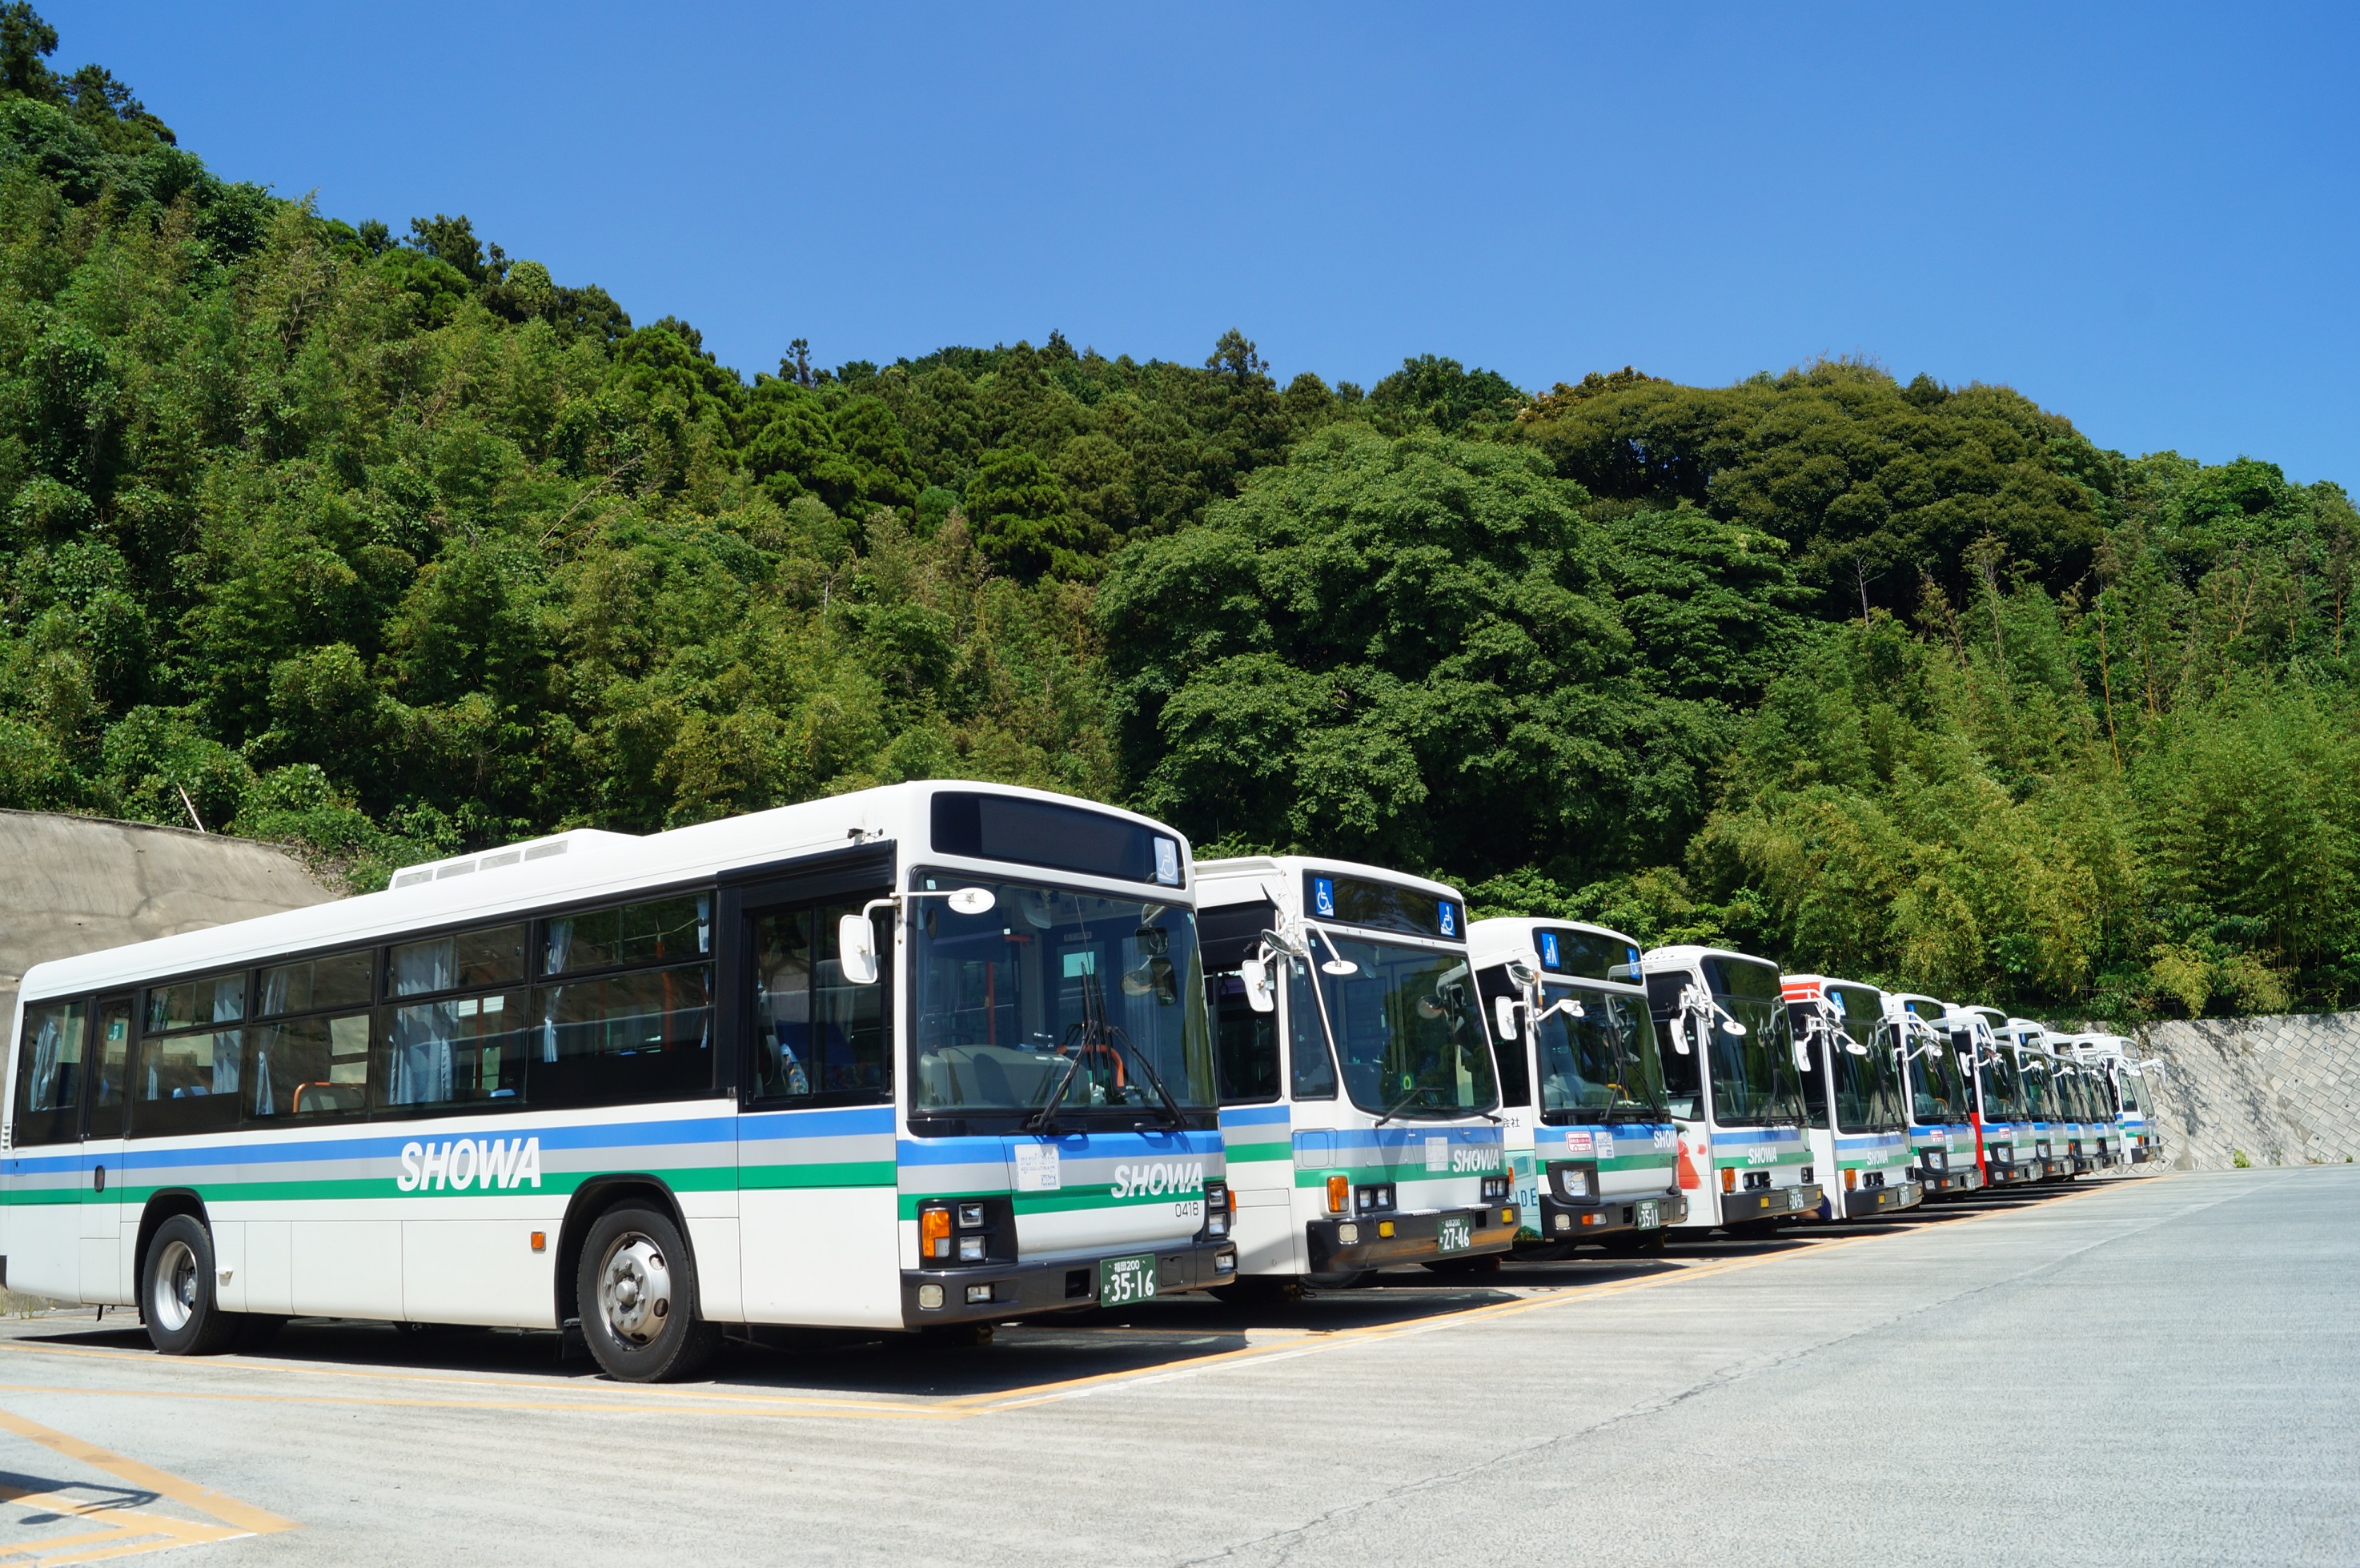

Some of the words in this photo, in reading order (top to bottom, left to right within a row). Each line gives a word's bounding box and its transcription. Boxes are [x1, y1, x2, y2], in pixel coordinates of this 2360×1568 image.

[396, 1137, 541, 1192] SHOWA
[1452, 1148, 1499, 1173] SHOWA
[1748, 1146, 1777, 1165] SHOWA
[1866, 1149, 1888, 1166] SHOWA
[1110, 1162, 1203, 1198] SHOWA
[1508, 1188, 1538, 1208] IDE
[1174, 1202, 1198, 1217] 0418
[1640, 1209, 1659, 1228] 35-11
[1443, 1226, 1470, 1250] 27-46
[1110, 1269, 1154, 1302] 35-16
